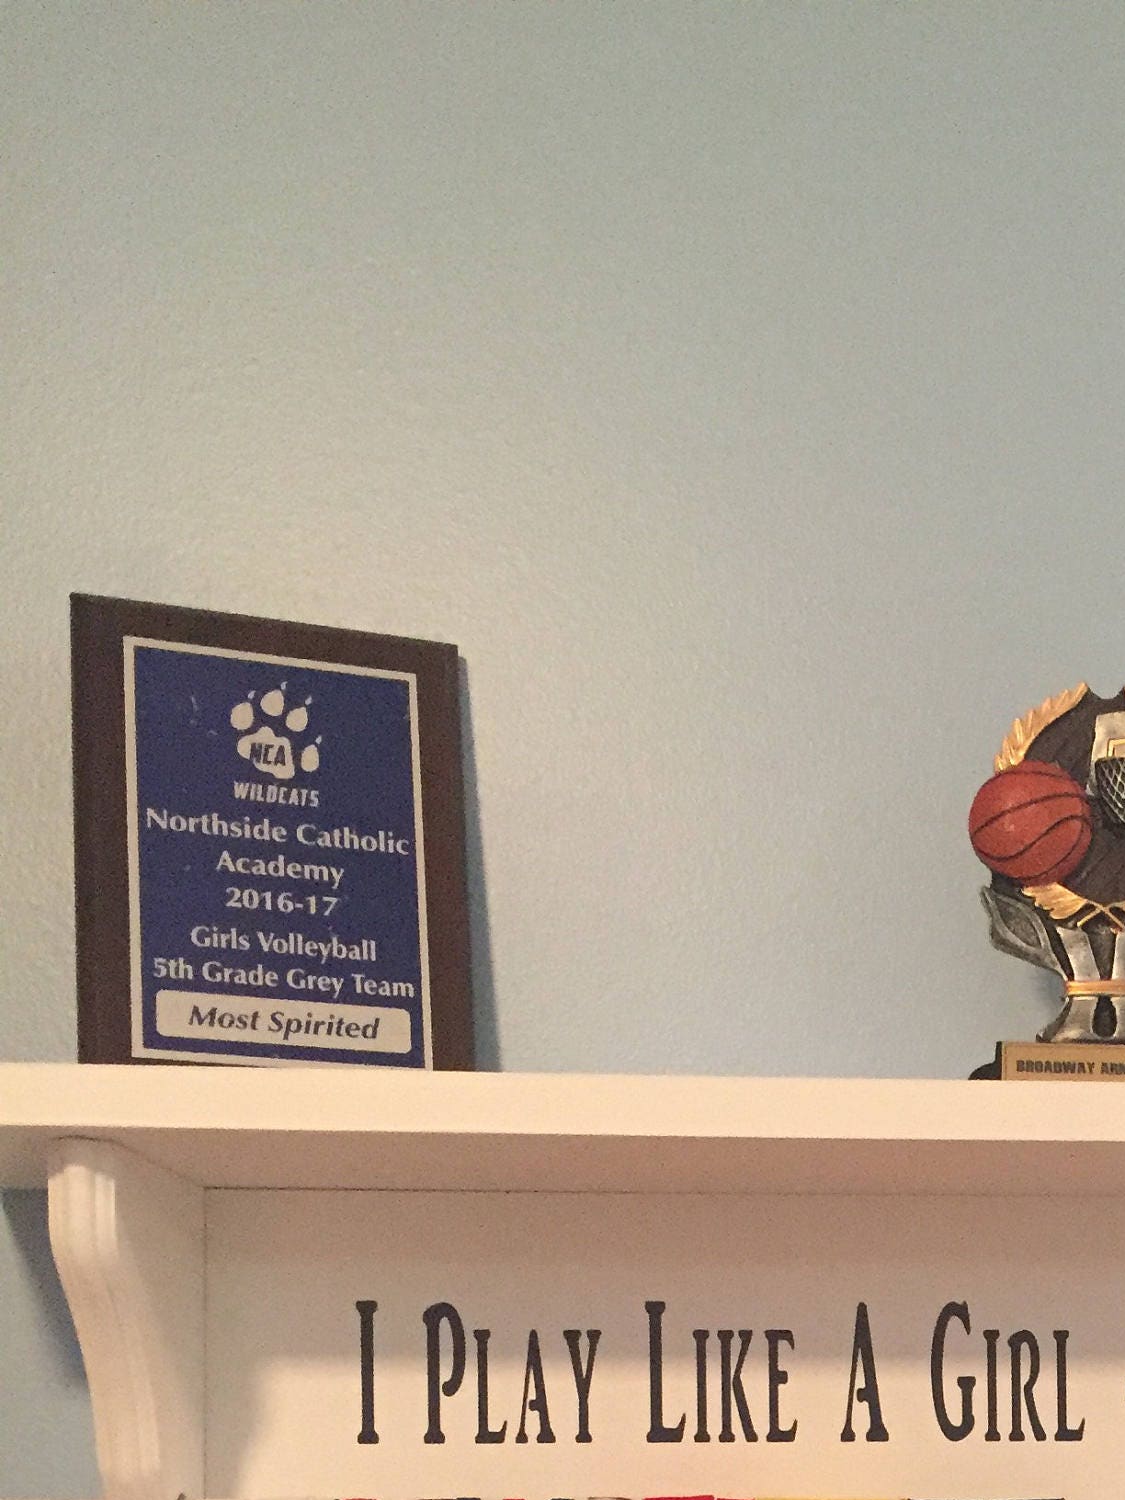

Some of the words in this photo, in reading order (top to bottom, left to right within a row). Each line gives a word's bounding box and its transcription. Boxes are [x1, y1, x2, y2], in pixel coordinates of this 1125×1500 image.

[249, 742, 287, 767] NCA
[233, 780, 320, 808] WILDCATS
[146, 808, 287, 843] Northside
[296, 823, 411, 856] Catholic
[216, 850, 344, 888] Academy
[225, 886, 339, 916] 2016-17
[190, 926, 251, 952] Girls
[257, 931, 376, 963] Volleyball
[153, 957, 194, 980] 5th
[202, 961, 279, 988] Grade
[286, 970, 345, 998] Grey
[351, 973, 415, 998] Team
[188, 1005, 259, 1032] Most
[267, 1010, 381, 1041] Spirited
[1016, 1058, 1096, 1075] BROADWAY
[356, 1300, 379, 1444] I
[422, 1301, 602, 1444] PLAY
[645, 1300, 798, 1443] LIKE
[840, 1301, 890, 1443] A
[930, 1300, 1086, 1443] GIRL
